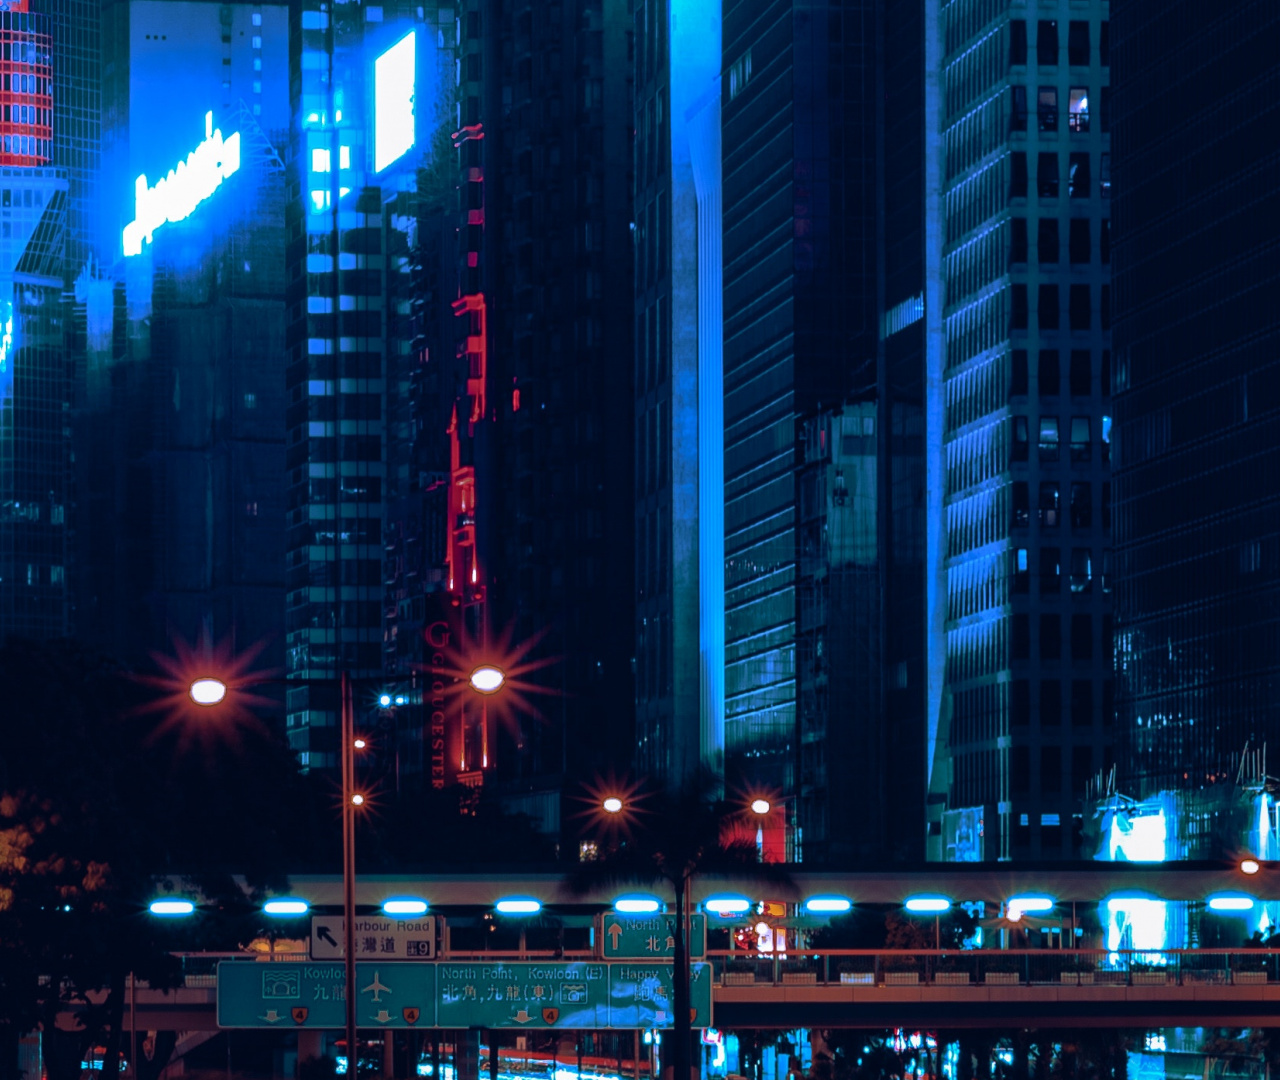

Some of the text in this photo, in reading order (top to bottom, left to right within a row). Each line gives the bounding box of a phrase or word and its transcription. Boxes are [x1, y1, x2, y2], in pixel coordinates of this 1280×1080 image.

[431, 653, 445, 790] GLOUCESTER
[343, 920, 430, 931] arbour Road
[626, 919, 660, 931] North
[419, 942, 428, 955] 9
[645, 935, 675, 952] 北角
[304, 967, 357, 979] Kowlo
[441, 966, 603, 981] North Point, Kowloon (E)
[620, 967, 701, 982] Happy Vey
[313, 983, 347, 1001] 九龍
[633, 985, 675, 1001] 跑馬
[295, 1011, 304, 1020] 4
[407, 1011, 415, 1020] 4
[546, 1011, 555, 1020] 4
